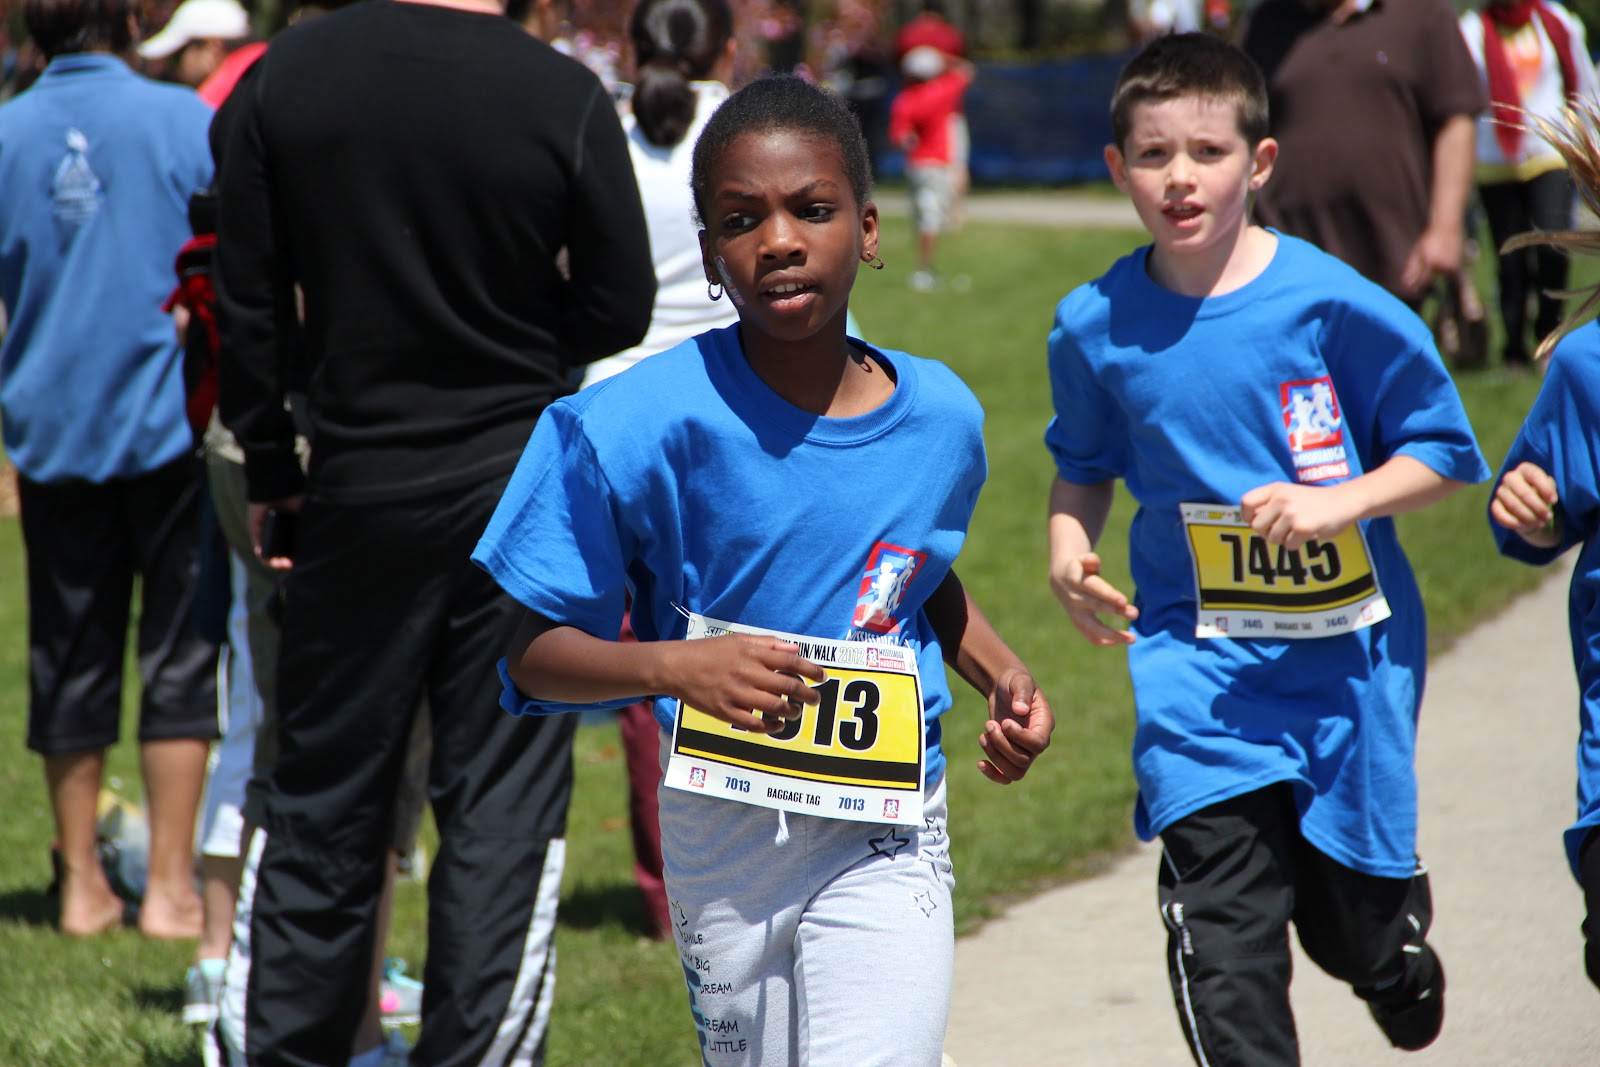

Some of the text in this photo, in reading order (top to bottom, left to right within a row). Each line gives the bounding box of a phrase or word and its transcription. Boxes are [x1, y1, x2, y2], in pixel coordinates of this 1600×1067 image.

[1220, 532, 1342, 587] 7445
[794, 641, 838, 662] UN/WALK
[838, 647, 865, 665] 2012
[725, 776, 865, 811] 7013 BAGGAGE TAG 7013
[695, 956, 710, 973] BIG
[709, 1039, 747, 1053] LITTLE
